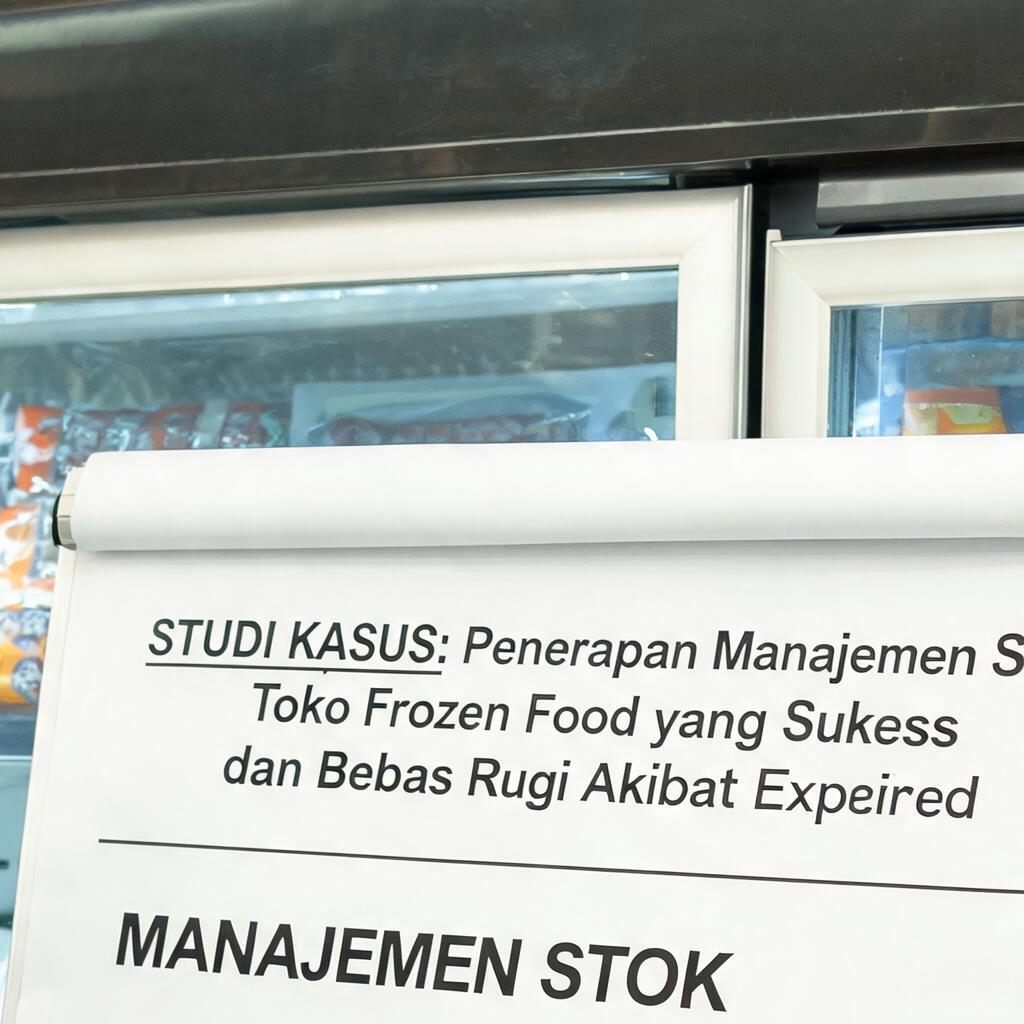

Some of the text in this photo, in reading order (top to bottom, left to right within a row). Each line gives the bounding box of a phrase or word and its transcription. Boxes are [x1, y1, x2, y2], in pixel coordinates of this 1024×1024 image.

[148, 618, 277, 659] STUDI
[288, 620, 449, 665] KASUS:
[463, 626, 697, 680] Penerapan
[712, 630, 977, 685] Manajemen
[253, 682, 959, 752] Toko Frozen Food yang Sukess
[223, 744, 980, 825] dan Bebas Rugi Akibat Expeired
[115, 912, 735, 1013] MANAJEMEN STOK
